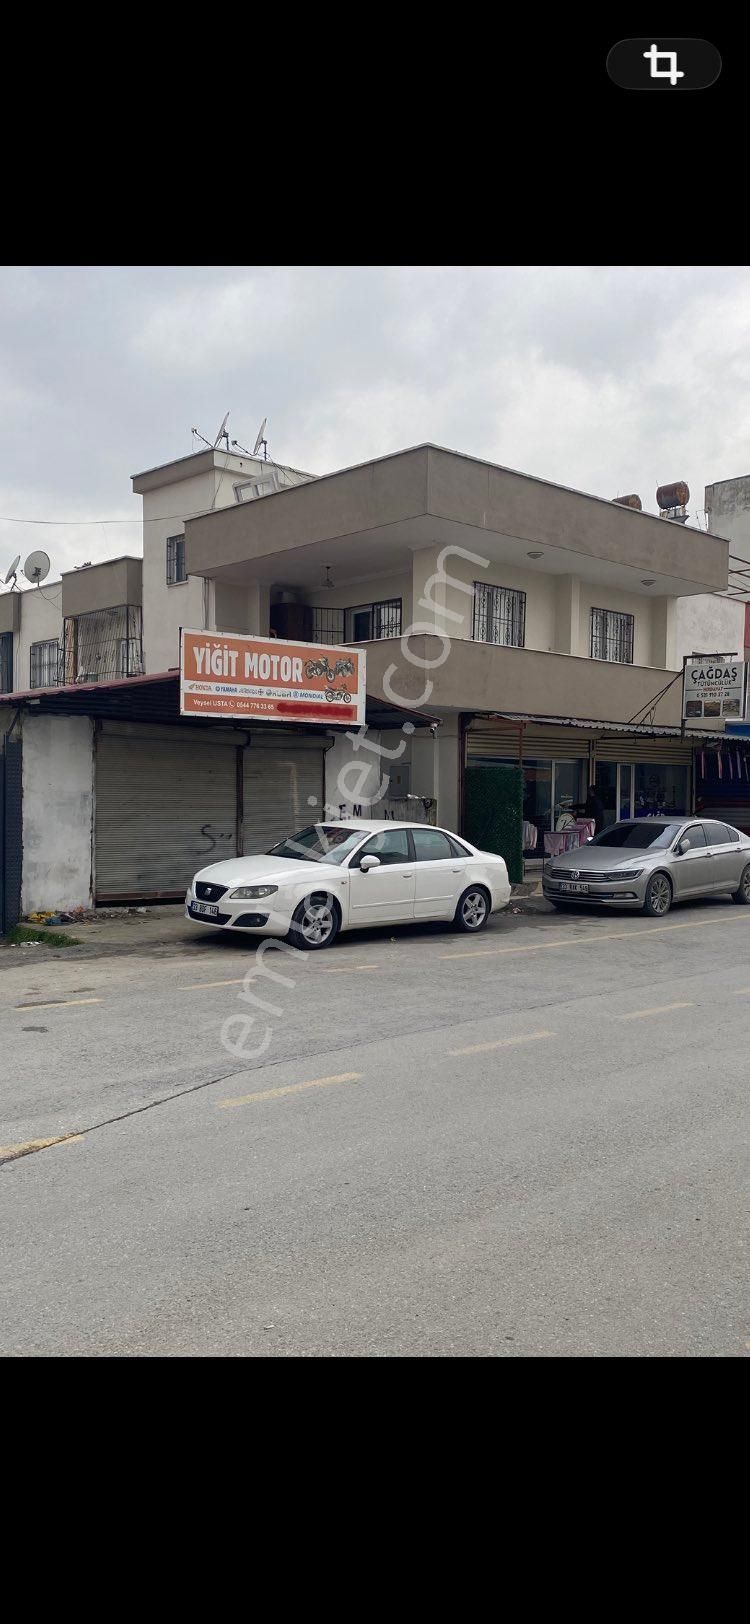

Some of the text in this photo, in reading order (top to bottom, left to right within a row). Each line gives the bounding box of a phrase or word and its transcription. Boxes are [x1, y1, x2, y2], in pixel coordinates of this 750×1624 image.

[192, 642, 304, 683] YİĞİT MOTOR
[691, 666, 738, 684] ÇAĞDAŞ
